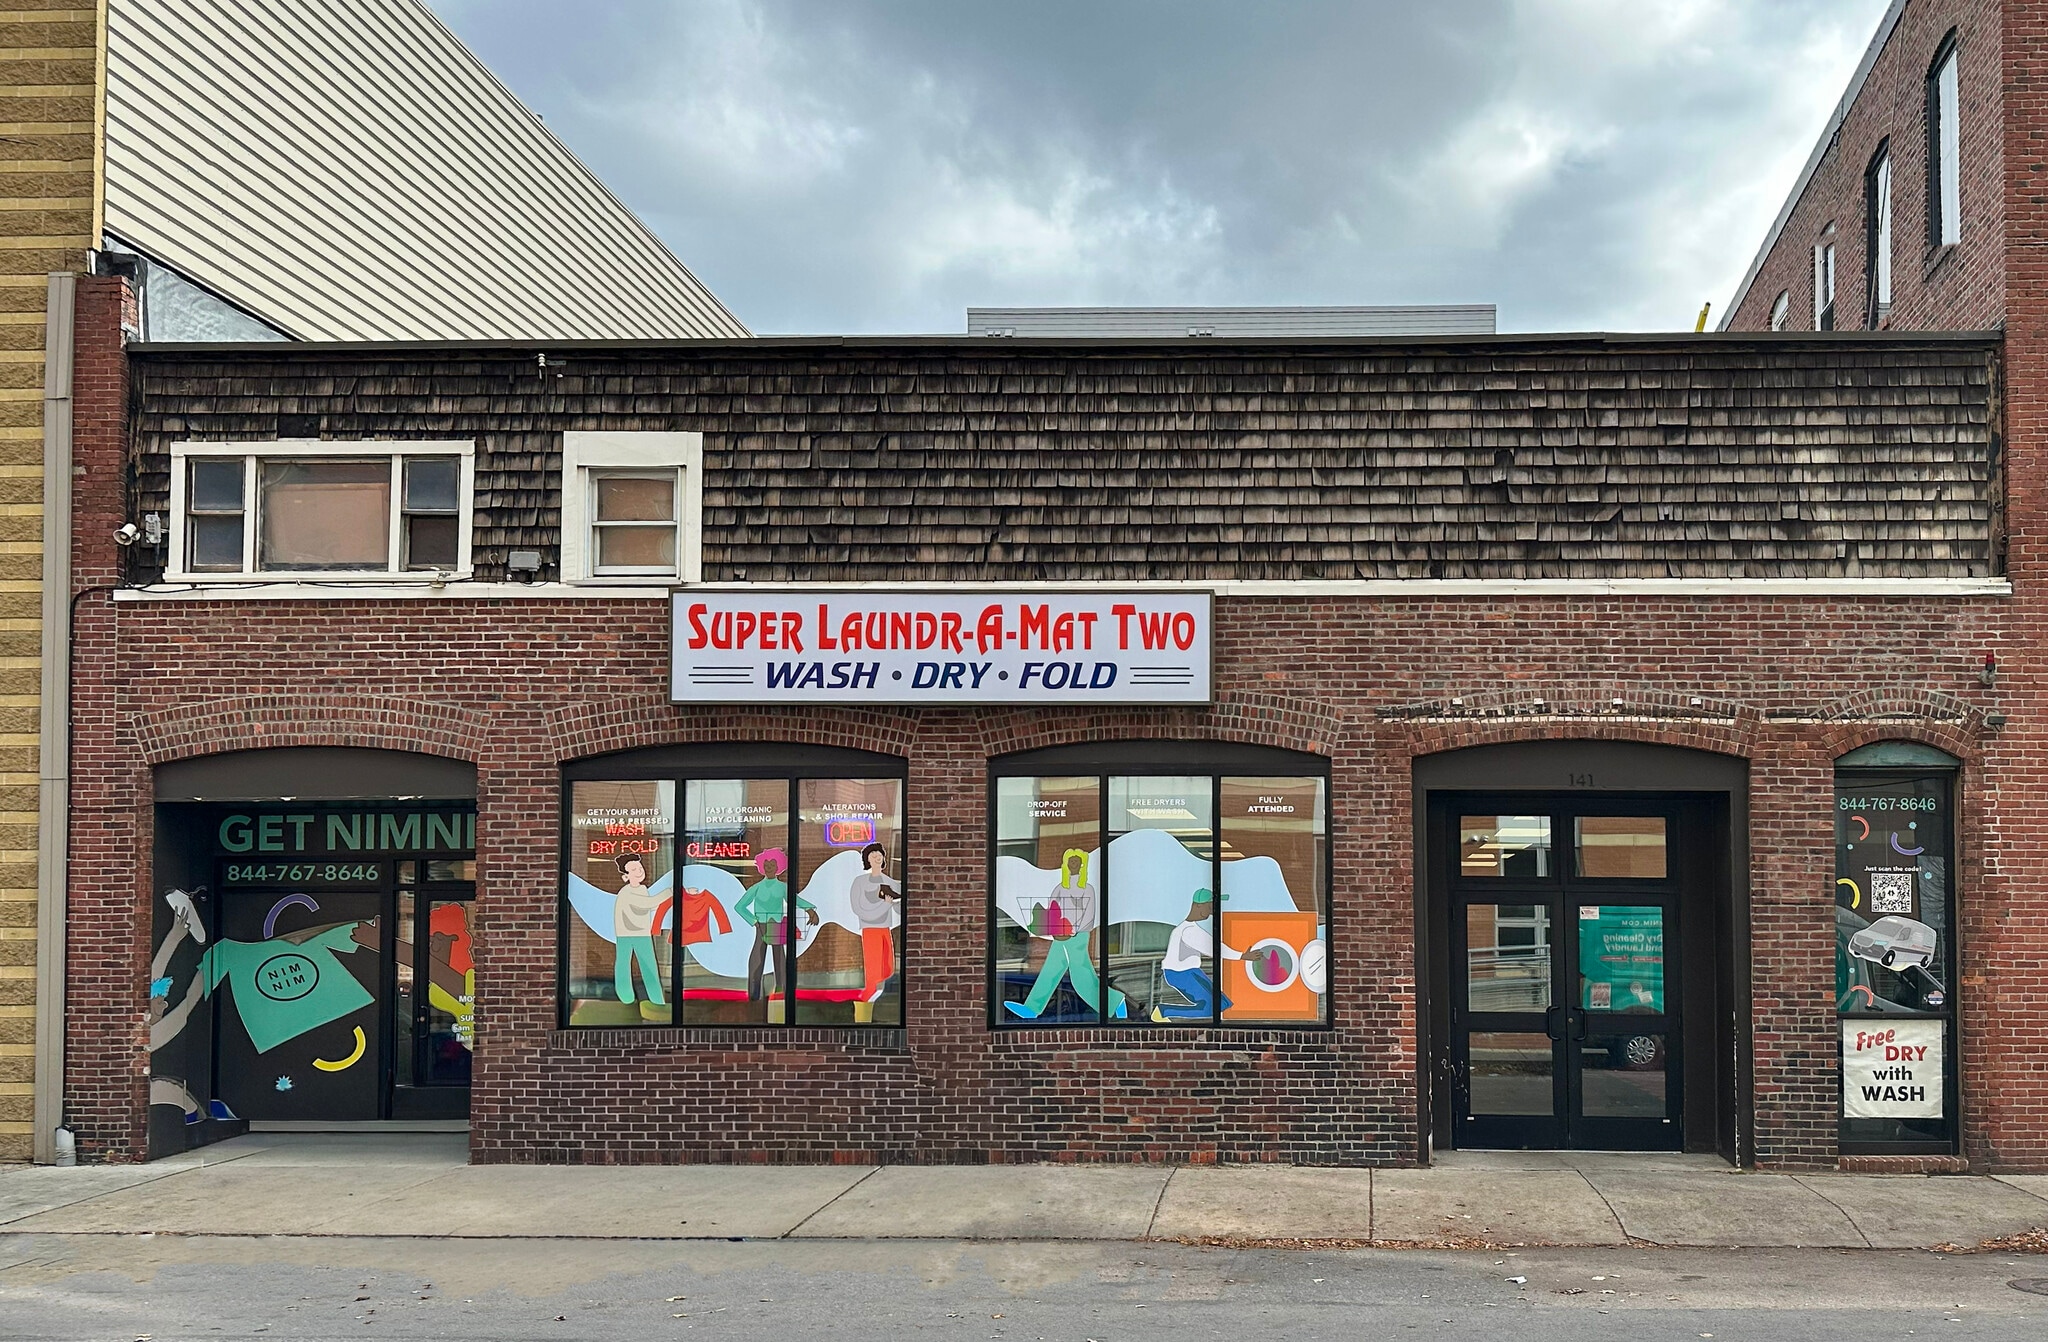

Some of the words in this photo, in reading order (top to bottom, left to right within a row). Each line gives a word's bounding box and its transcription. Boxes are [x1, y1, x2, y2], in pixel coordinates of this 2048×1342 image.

[688, 603, 804, 655] SUPER
[818, 603, 1098, 655] LAUNDR-A-MAT
[1111, 604, 1196, 651] TWO
[767, 662, 880, 689] WASH
[911, 662, 992, 689] DRY
[1019, 662, 1118, 689] FOLD
[1569, 773, 1595, 787] 141
[822, 803, 876, 811] ALTERATIONS
[1131, 798, 1151, 806] FREE
[1153, 798, 1186, 806] DRYERS
[1258, 796, 1284, 804] FULLY
[1839, 797, 1936, 811] 844-767-8646
[587, 808, 604, 816] GET
[605, 808, 629, 816] YOUR
[630, 808, 659, 816] SHIRTS
[735, 806, 772, 814] ORGANIC
[1247, 805, 1295, 813] ATTENDED
[726, 815, 772, 823] CLEANING
[219, 815, 314, 852] GET
[605, 823, 645, 836] WASH
[829, 822, 873, 842] OPEN
[590, 840, 617, 854] DRY
[620, 839, 658, 853] FOLD
[686, 842, 750, 858] CLEANER
[227, 865, 379, 881] 844-767-8646
[268, 963, 301, 980] NIM
[272, 974, 305, 992] NIM
[1856, 1028, 1896, 1051] Free
[1885, 1046, 1928, 1061] DRY
[1873, 1066, 1912, 1080] with
[1861, 1086, 1924, 1101] WASH
